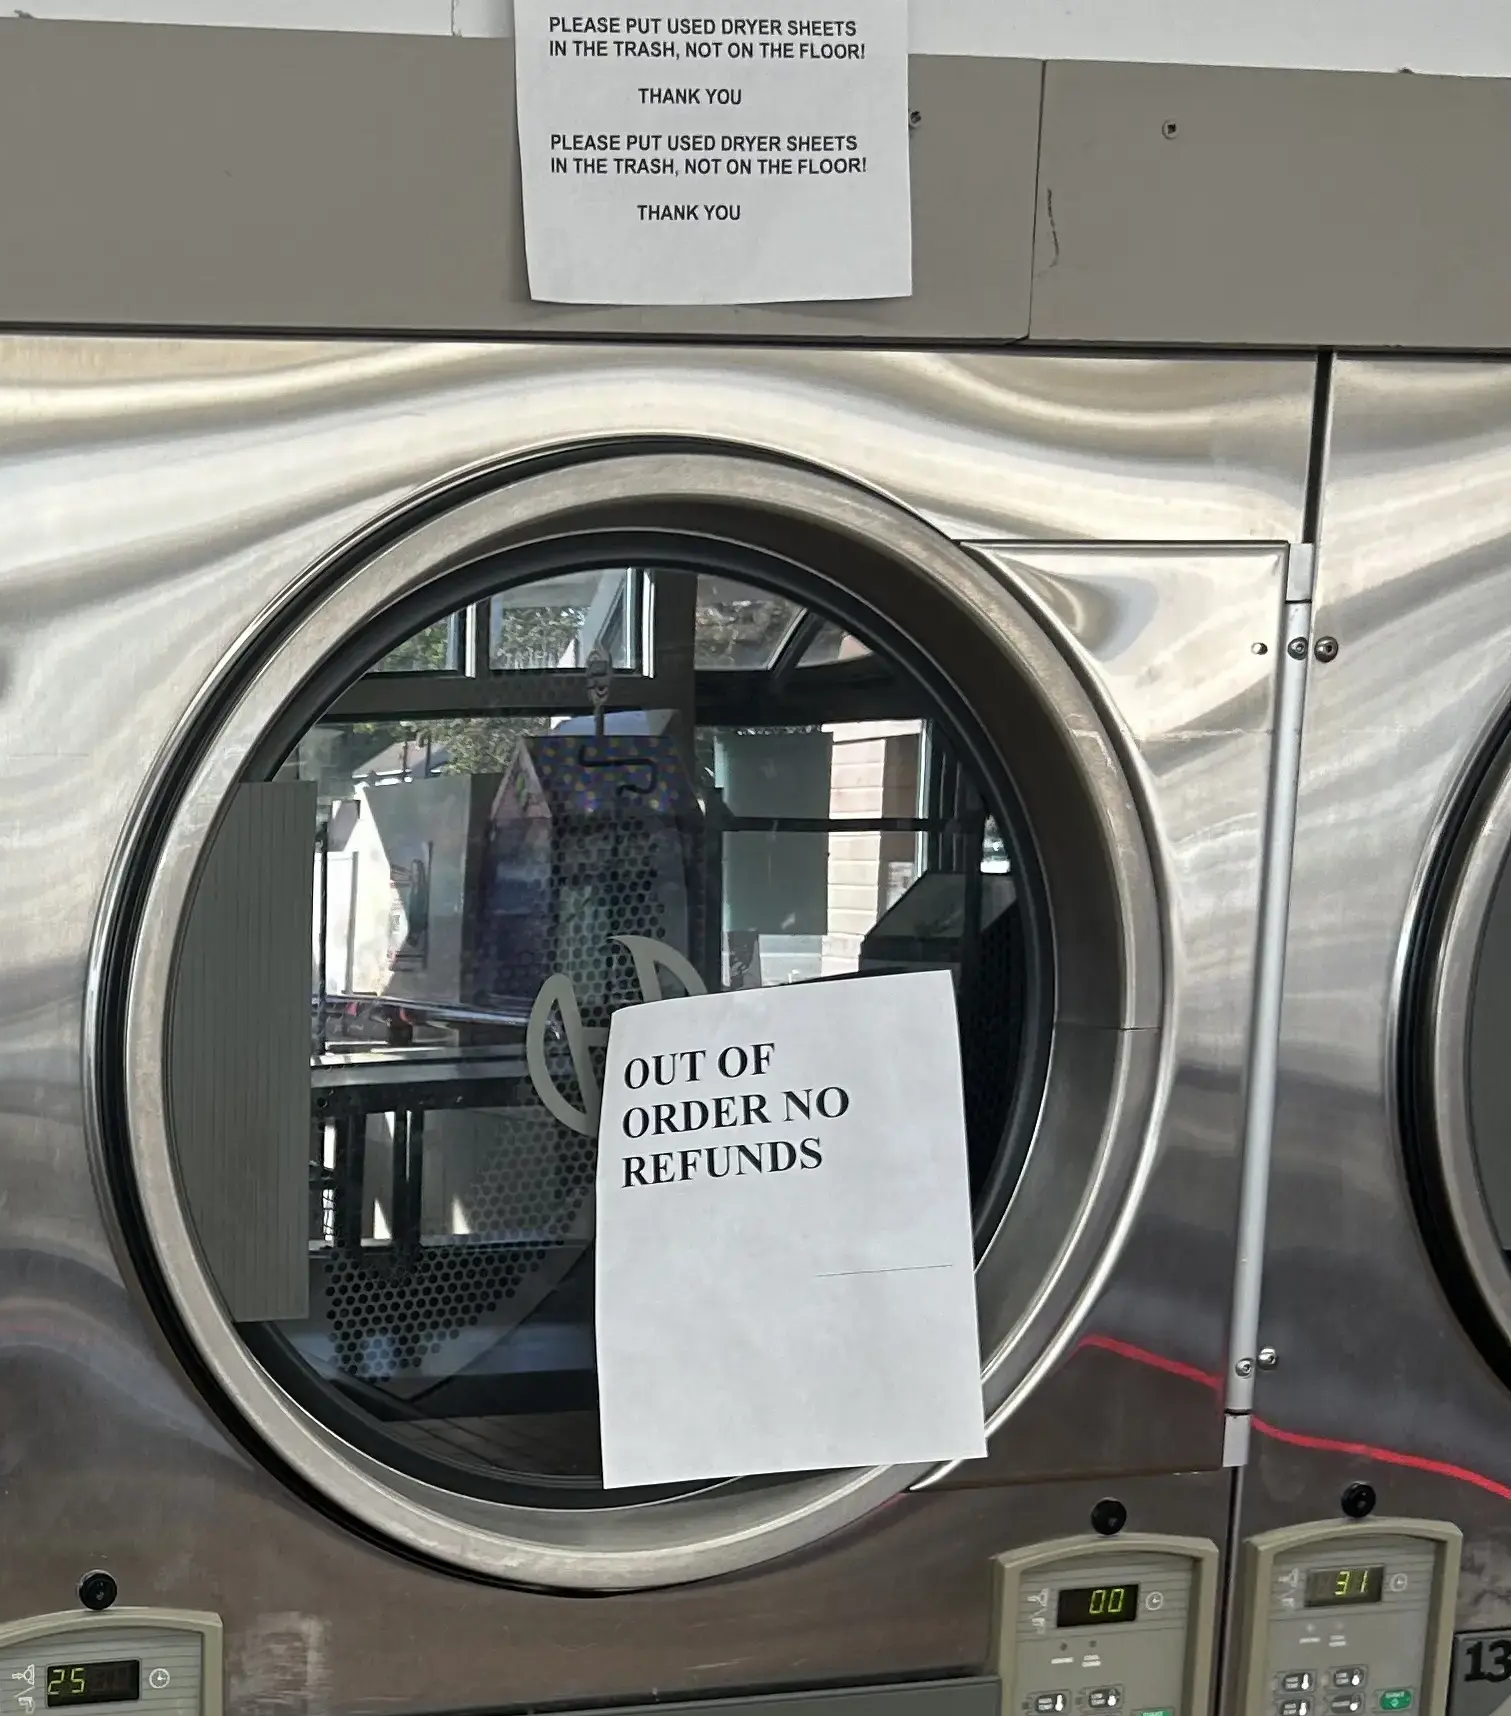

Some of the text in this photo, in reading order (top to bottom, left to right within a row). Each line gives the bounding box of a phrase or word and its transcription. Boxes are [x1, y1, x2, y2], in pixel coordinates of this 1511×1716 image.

[549, 16, 857, 37] PLEASE PUT USED DRYER SHEETS
[549, 40, 865, 61] IN THE TRASH, NOT ON THE FLOOR!
[637, 87, 742, 105] THANK YOU
[551, 134, 858, 152] PLEASE PUT USED DRYER SHEETS
[551, 157, 867, 177] IN THE TRASH, NOT ON THE FLOOR!
[636, 204, 741, 221] THANK YOU
[624, 1042, 775, 1090] OUT OF
[622, 1086, 850, 1139] ORDER NO
[621, 1137, 823, 1189] REFUNDS
[1334, 1570, 1368, 1596] 31
[1089, 1588, 1124, 1614] 00
[1464, 1639, 1511, 1683] 13
[47, 1667, 86, 1695] 25
